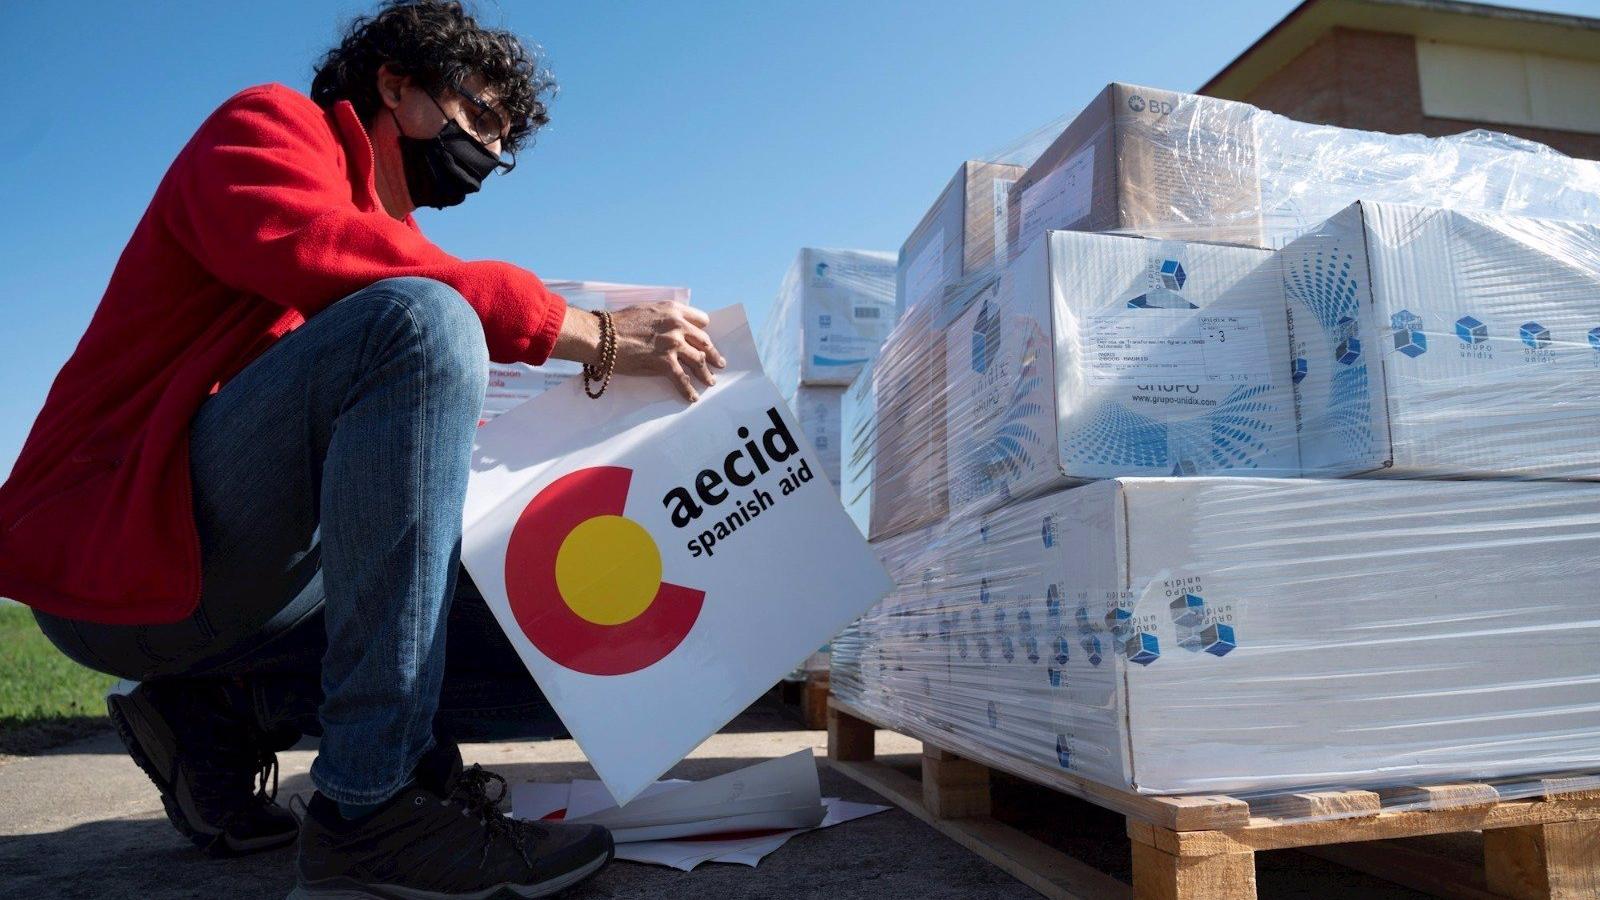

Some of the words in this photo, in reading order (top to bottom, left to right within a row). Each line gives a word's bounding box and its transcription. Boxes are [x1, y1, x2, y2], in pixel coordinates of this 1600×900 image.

[1149, 100, 1172, 115] BD
[1218, 330, 1226, 343] 3
[1459, 343, 1493, 352] GRUPO
[1459, 351, 1494, 360] unidix
[1131, 394, 1217, 407] www.grupo-unidix.com
[662, 406, 800, 529] aecid
[687, 489, 775, 558] spanish
[778, 457, 814, 496] aid
[1164, 576, 1202, 588] unidix
[1165, 585, 1203, 598] GRUPO
